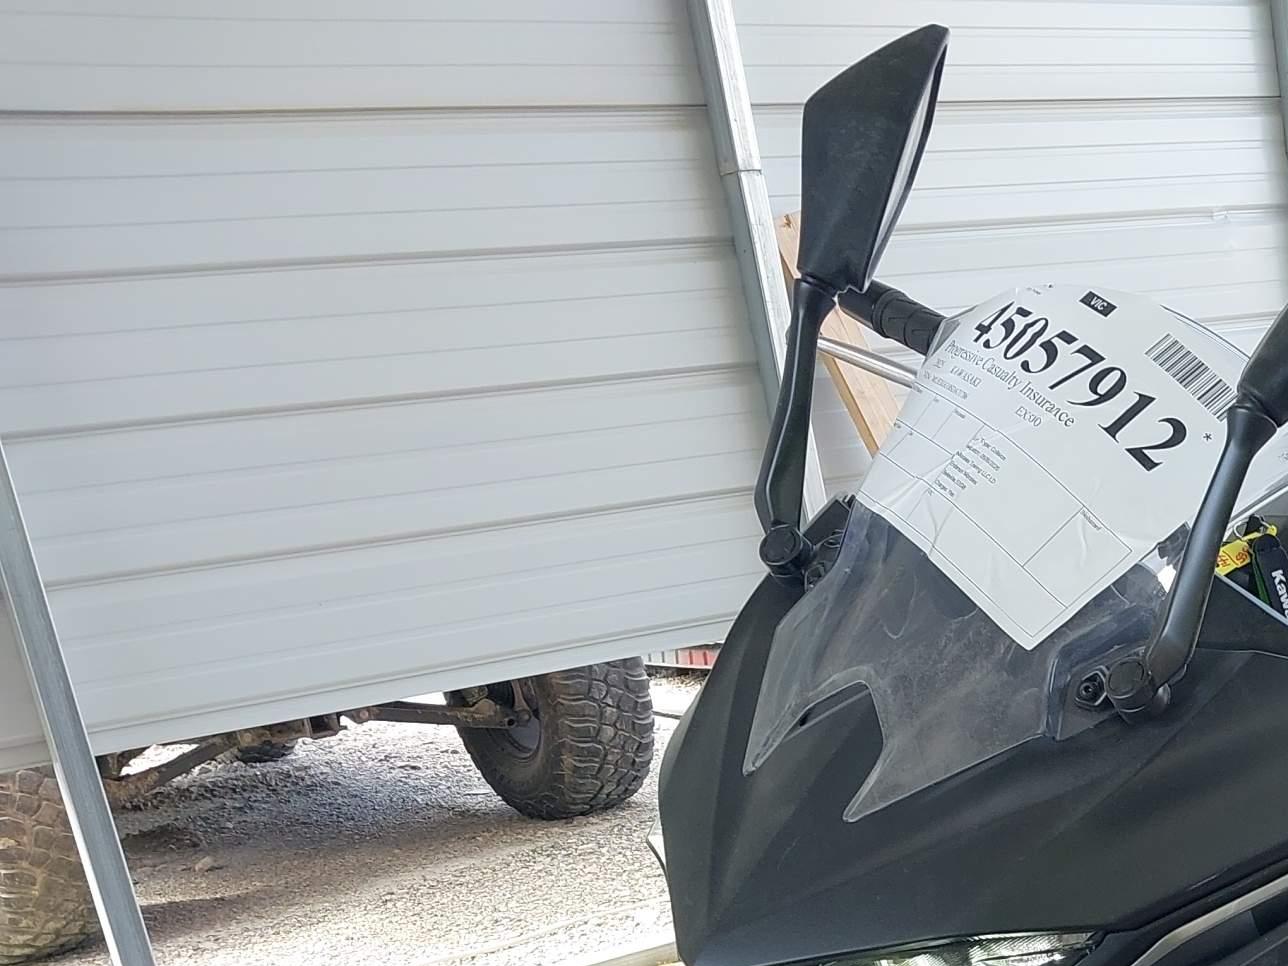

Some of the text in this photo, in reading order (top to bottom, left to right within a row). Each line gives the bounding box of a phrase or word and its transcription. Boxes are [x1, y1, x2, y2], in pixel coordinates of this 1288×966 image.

[1090, 296, 1108, 311] VIC
[973, 301, 1187, 472] 45057912
[981, 356, 1022, 390] Casualty
[1019, 381, 1075, 427] Insurance
